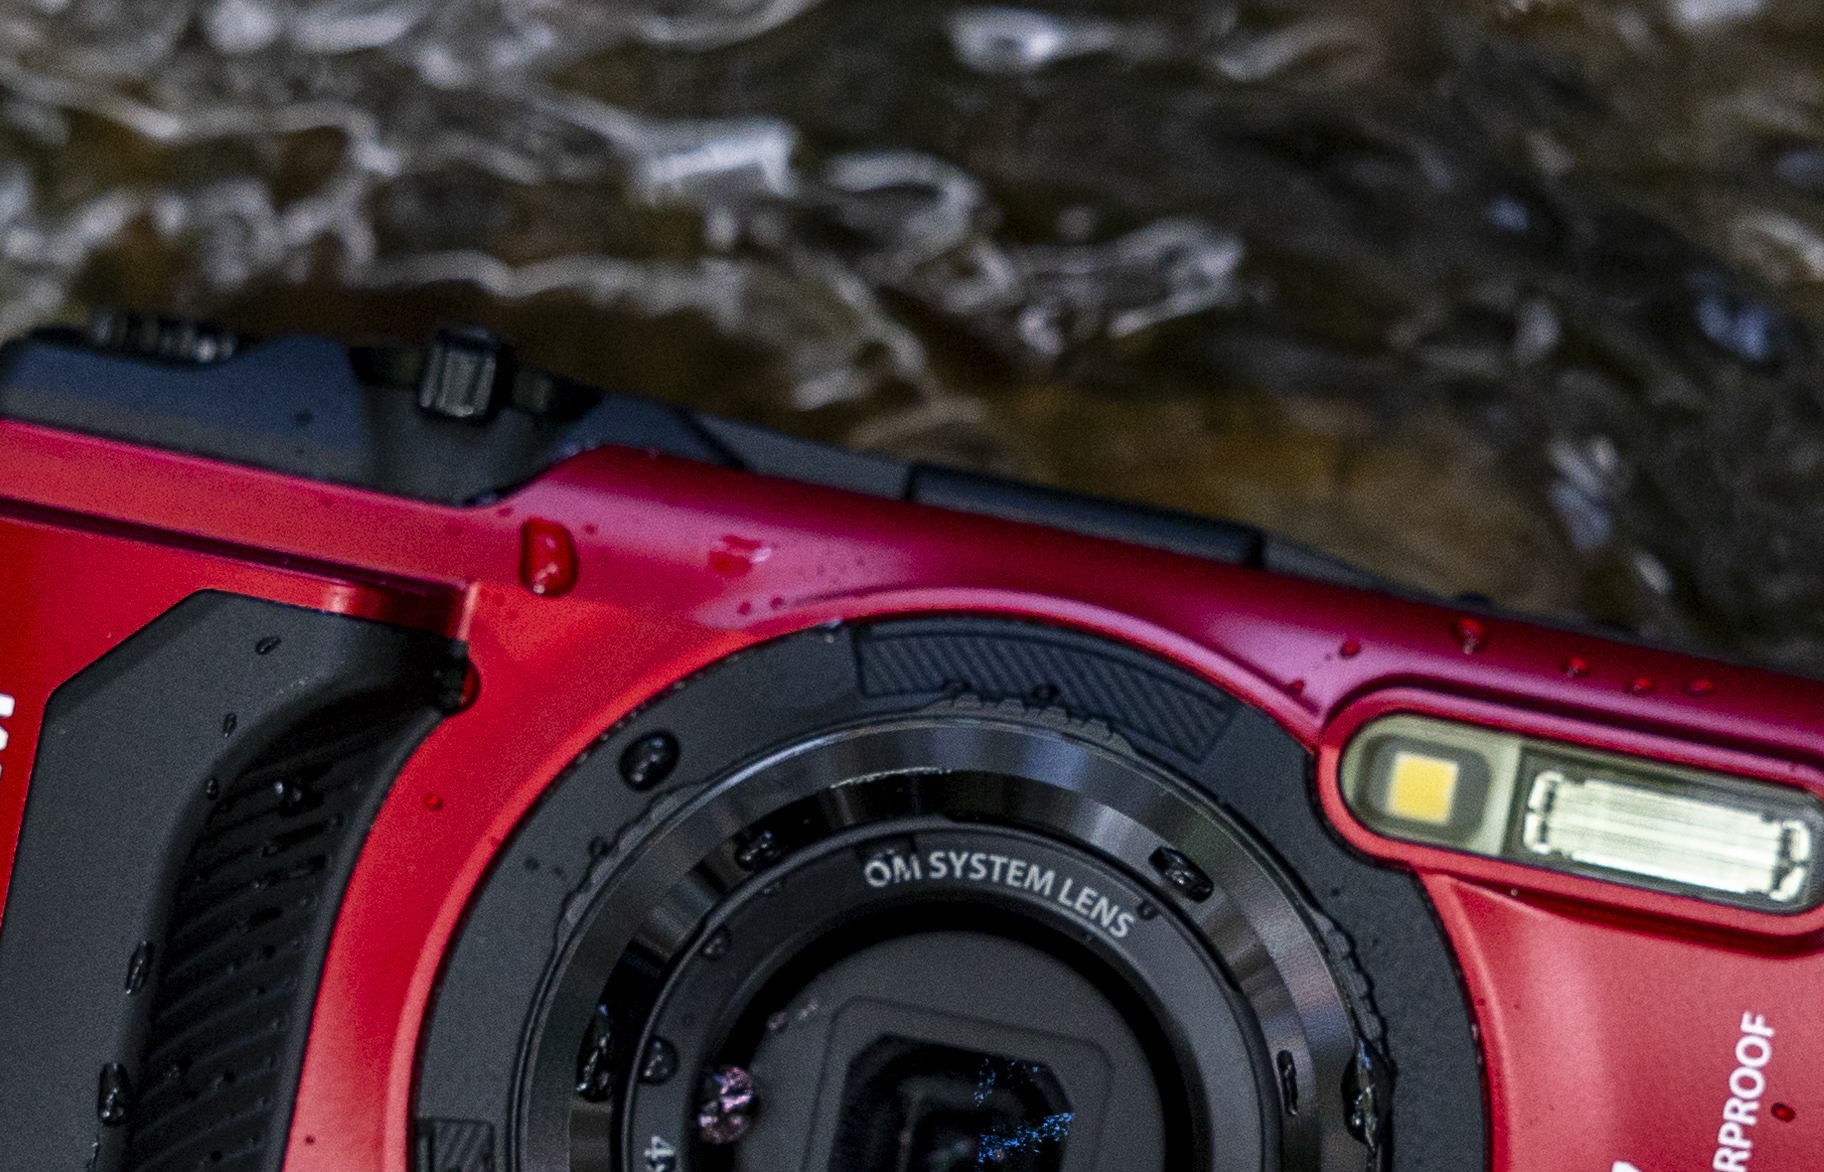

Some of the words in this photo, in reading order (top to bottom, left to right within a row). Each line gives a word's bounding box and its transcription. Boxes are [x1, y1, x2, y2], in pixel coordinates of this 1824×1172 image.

[864, 855, 922, 888] OM
[928, 851, 1056, 896] SYSTEM
[1058, 878, 1136, 938] LENS
